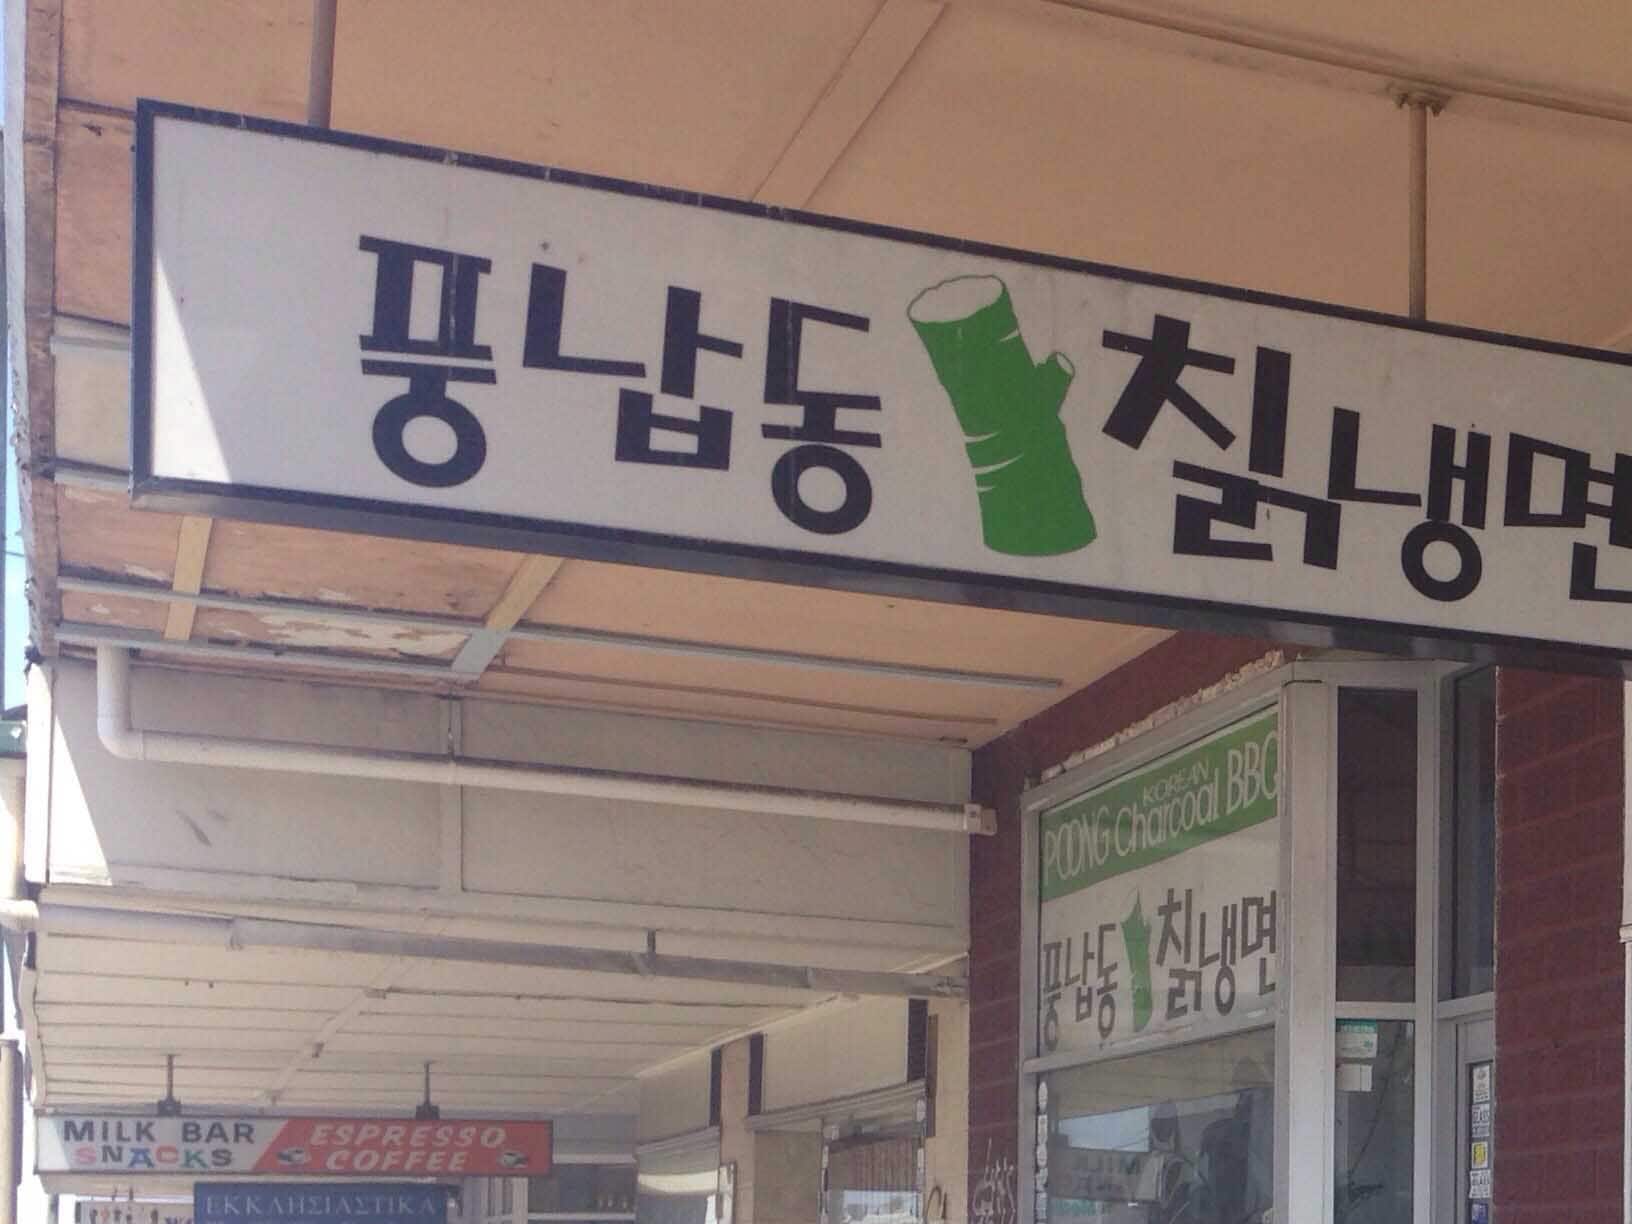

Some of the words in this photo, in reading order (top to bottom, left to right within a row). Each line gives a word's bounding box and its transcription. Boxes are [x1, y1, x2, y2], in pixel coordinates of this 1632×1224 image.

[358, 234, 883, 538] 풍납동
[1115, 767, 1220, 857] Charcoal
[1043, 923, 1119, 1051] 풍납동
[1155, 887, 1277, 1020] 칡냉면
[63, 1119, 156, 1142] MILK
[181, 1121, 255, 1144] BAR
[308, 1124, 508, 1148] ESPRESSO
[74, 1144, 233, 1168] SNACKS
[325, 1150, 471, 1172] COFFEE
